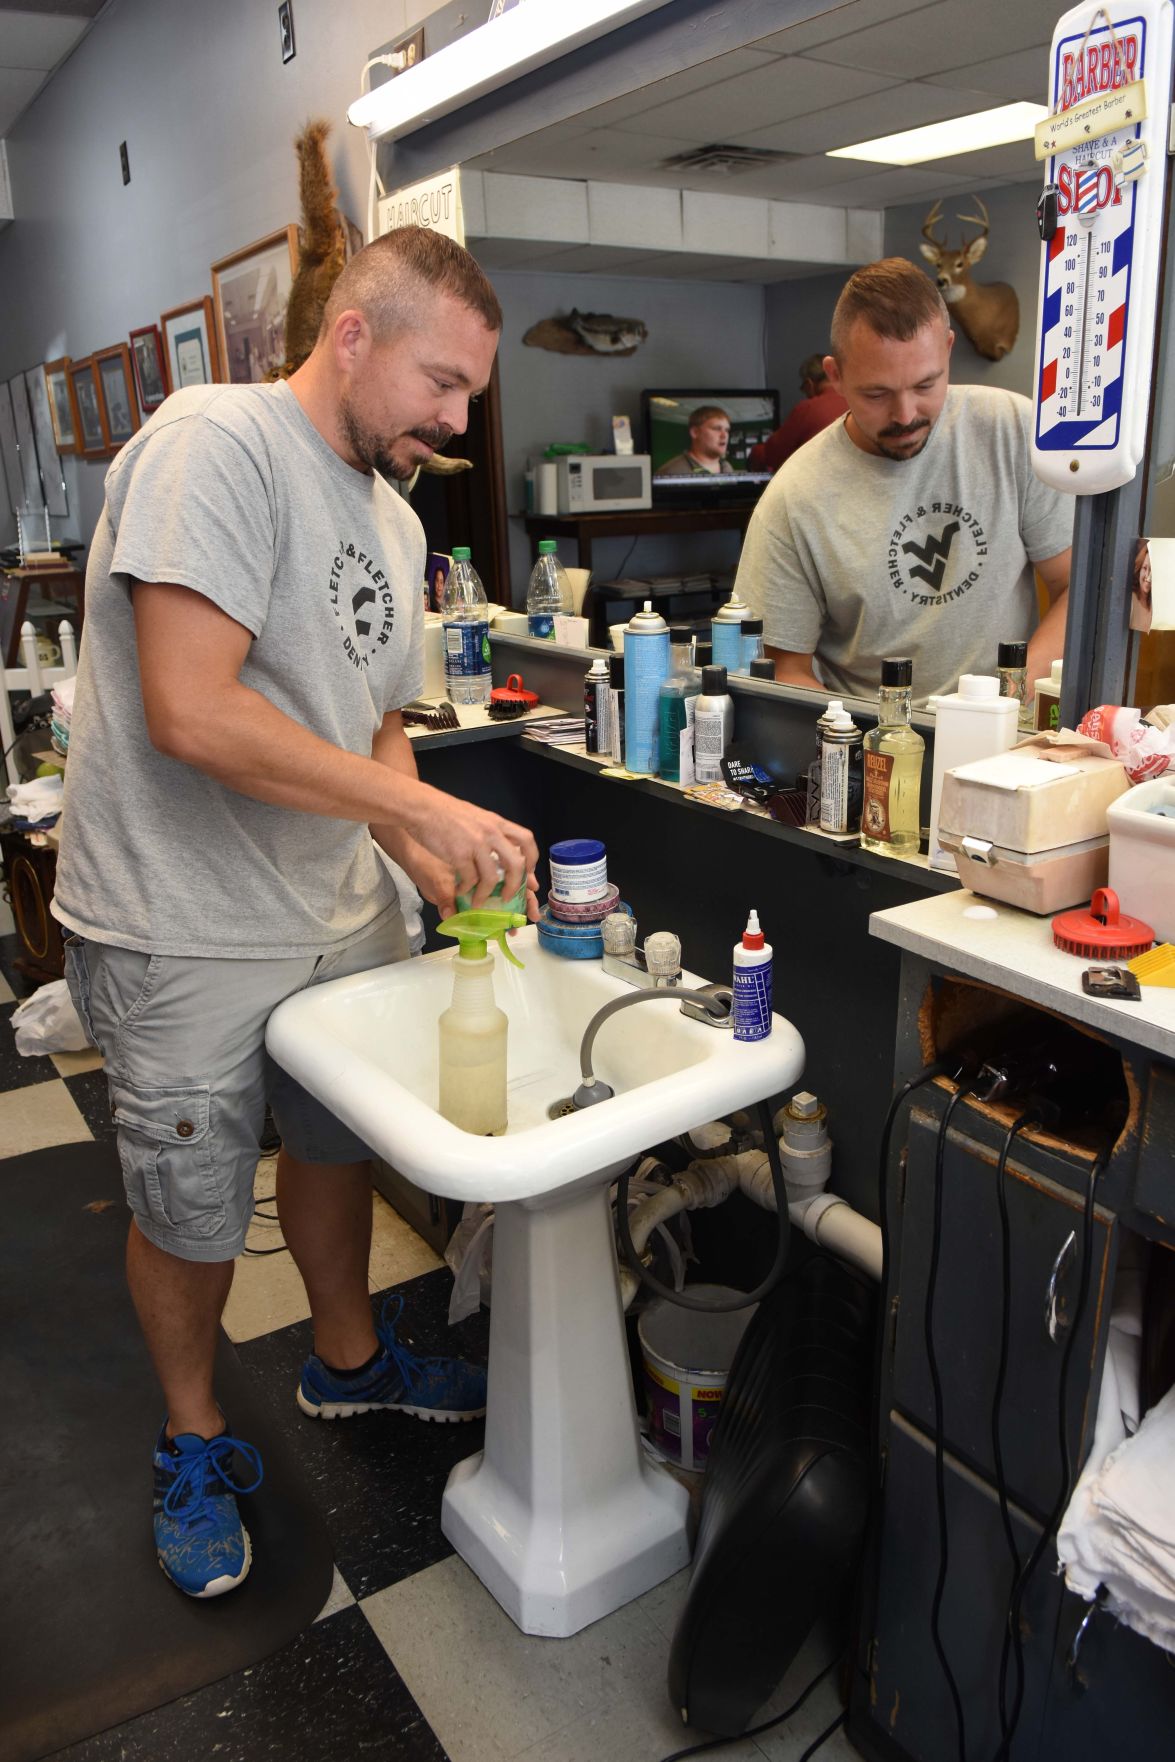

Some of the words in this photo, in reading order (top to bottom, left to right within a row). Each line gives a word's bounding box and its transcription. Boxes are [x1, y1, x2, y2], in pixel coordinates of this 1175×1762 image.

[1061, 34, 1138, 112] BARBER
[1074, 103, 1102, 123] Greatest
[1103, 94, 1127, 111] Barber
[1072, 139, 1101, 154] SHAVE
[1102, 137, 1110, 149] &
[1111, 136, 1117, 146] A
[1075, 149, 1112, 165] HAIRCUT
[388, 183, 453, 229] HAIRCUT
[1066, 234, 1077, 247] 120
[1101, 241, 1111, 253] 110
[1065, 258, 1075, 271] 100
[1099, 266, 1108, 278] 90
[1067, 282, 1075, 294] 80
[1097, 289, 1105, 301] 70
[1065, 305, 1073, 317] 60
[1096, 312, 1104, 324] 50
[1064, 326, 1072, 338] 40
[1094, 334, 1103, 346] 30
[1063, 347, 1071, 359] 20
[1093, 355, 1100, 367] 10
[1066, 367, 1071, 379] 0
[1092, 376, 1101, 387] -10
[1058, 387, 1068, 399] -20
[1090, 395, 1101, 407] -30
[1056, 406, 1067, 418] -40
[346, 543, 355, 559] &
[358, 552, 394, 646] FLETCHER
